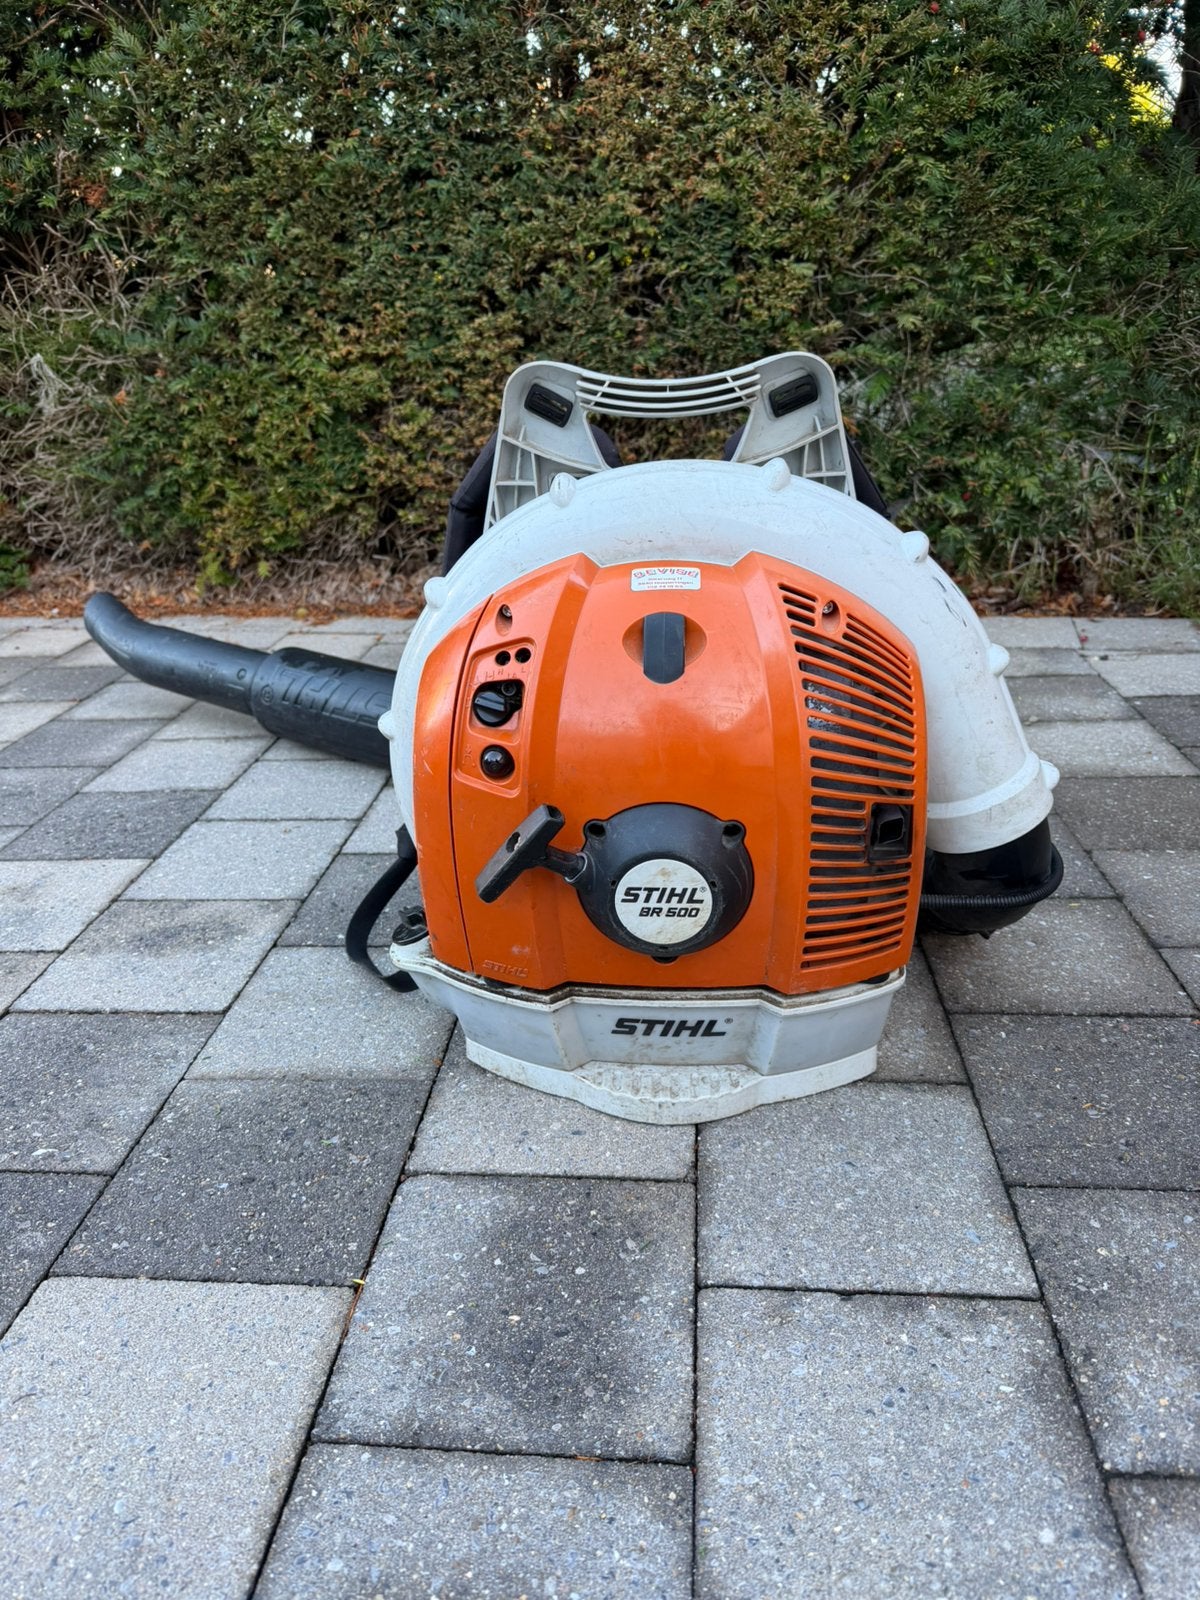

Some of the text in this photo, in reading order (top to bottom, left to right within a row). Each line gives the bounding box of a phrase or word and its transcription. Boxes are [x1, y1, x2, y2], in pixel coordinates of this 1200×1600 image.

[621, 887, 704, 904] STIHL
[639, 907, 700, 917] BR 500
[482, 960, 528, 977] STIHL
[611, 1018, 726, 1037] STIHL
